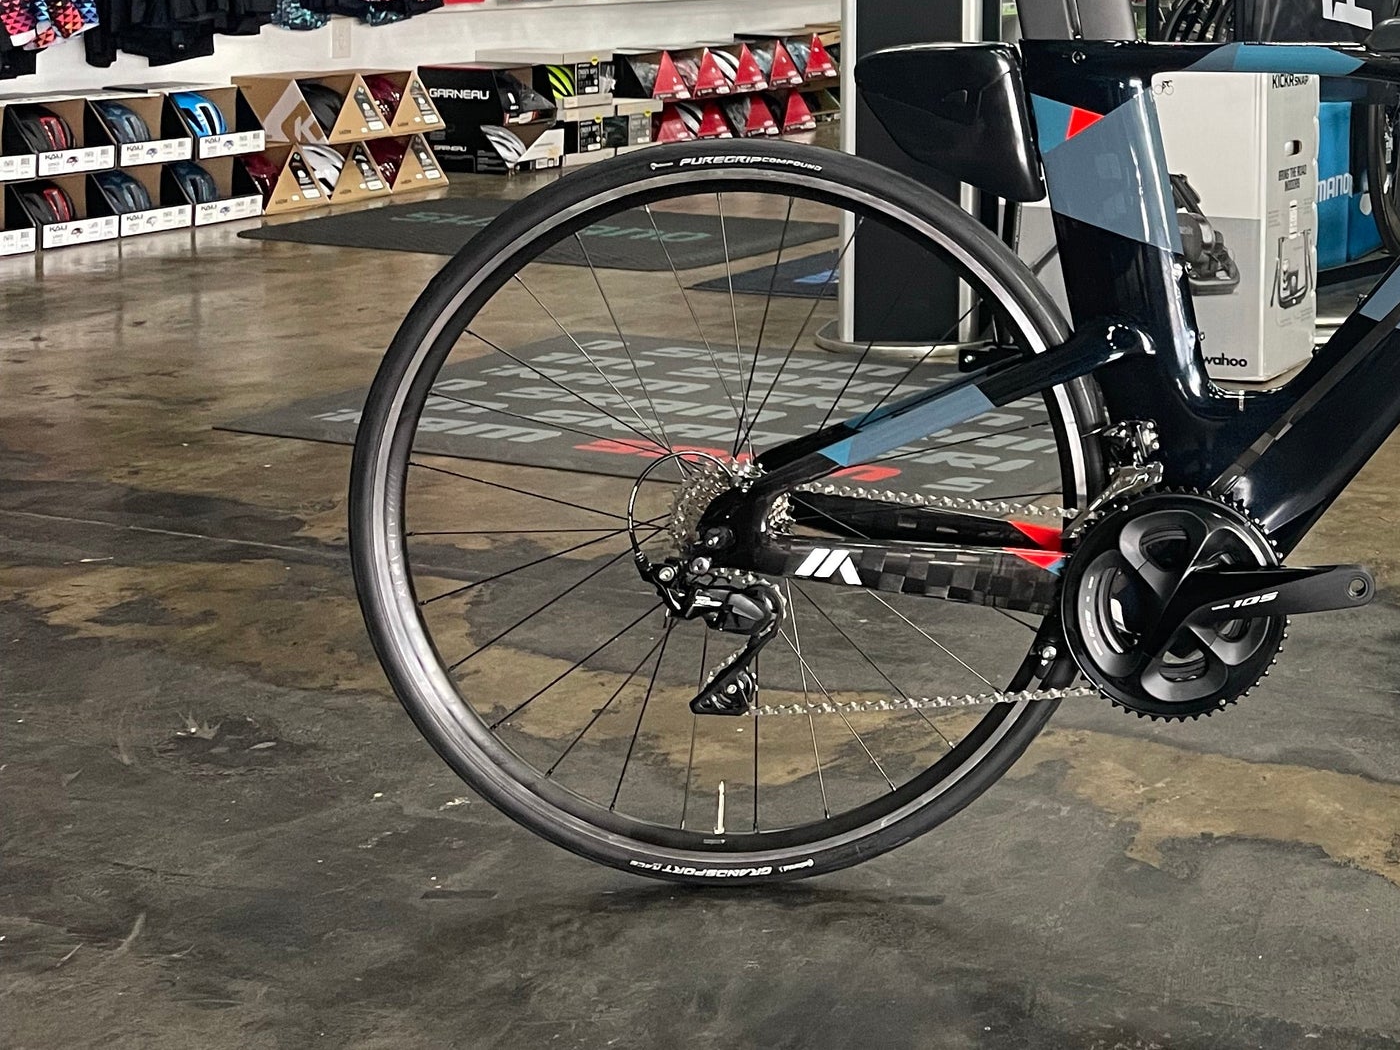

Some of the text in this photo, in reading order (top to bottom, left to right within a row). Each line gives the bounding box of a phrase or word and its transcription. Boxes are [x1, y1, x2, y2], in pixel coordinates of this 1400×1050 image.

[1272, 74, 1294, 89] KICKR
[429, 88, 490, 100] GARNEAU
[204, 136, 221, 144] KALI
[680, 156, 762, 167] PUREGRIP
[1318, 172, 1353, 202] MANO
[50, 224, 68, 232] KALI
[641, 346, 909, 377] SRAM
[1203, 353, 1248, 368] wahoo
[1233, 591, 1279, 608] 105
[662, 864, 773, 878] GRANDSPORT
